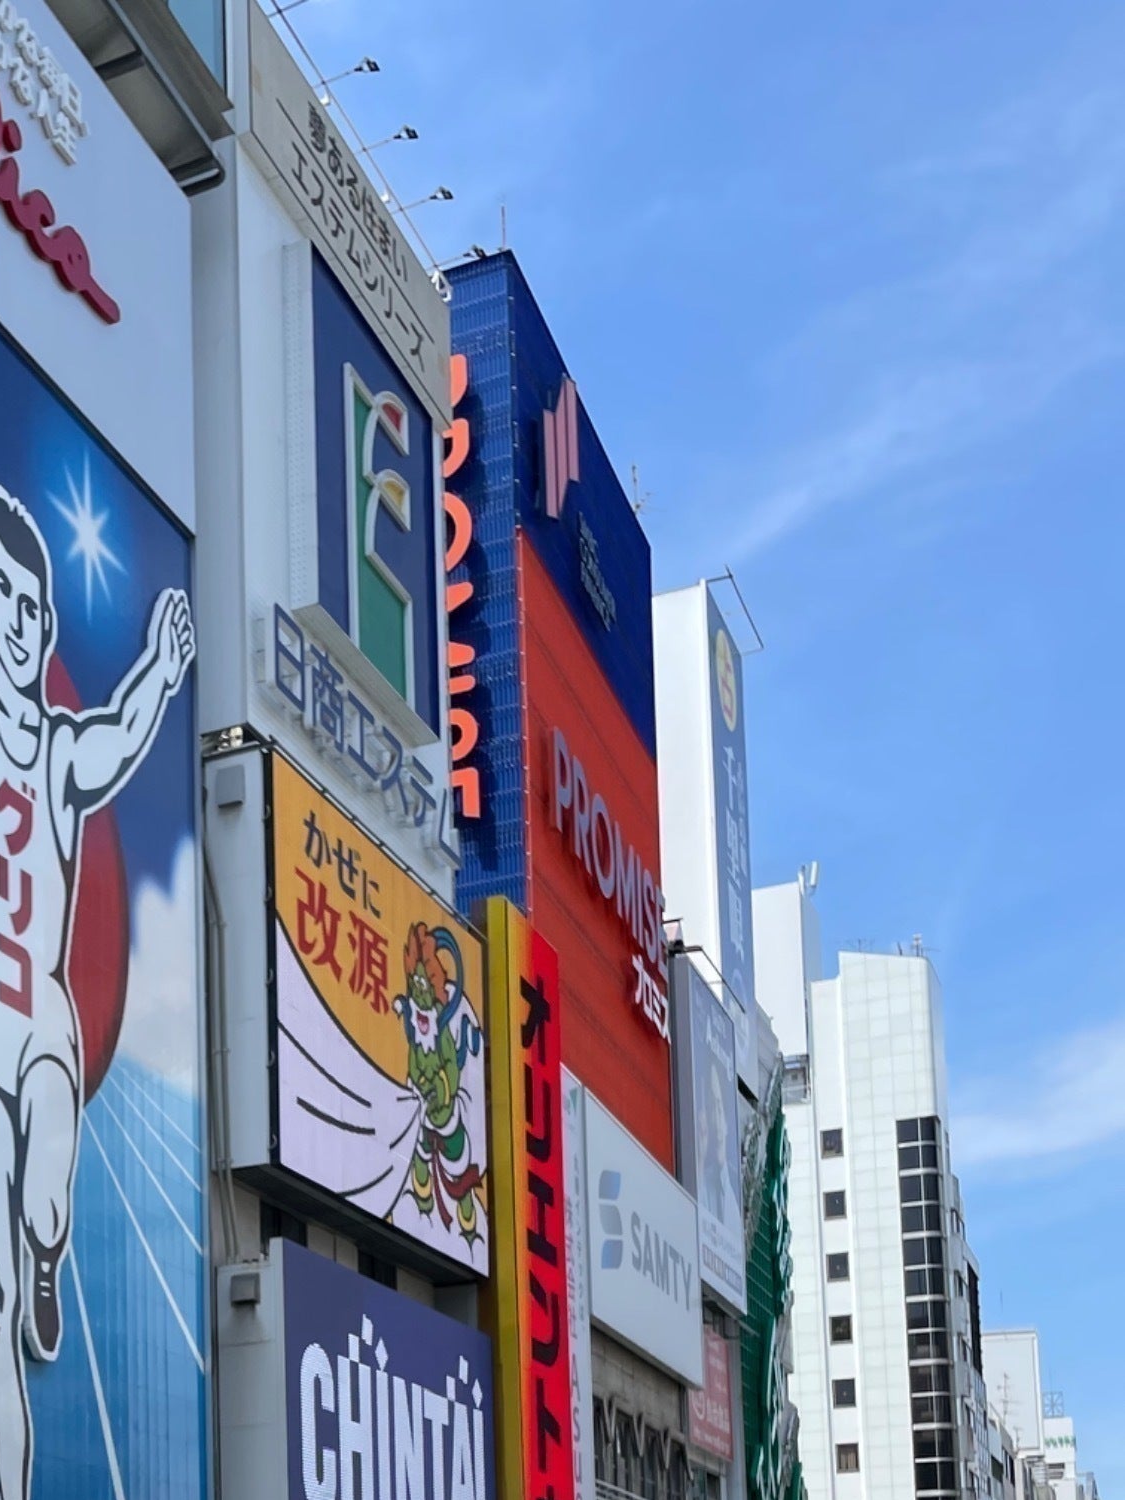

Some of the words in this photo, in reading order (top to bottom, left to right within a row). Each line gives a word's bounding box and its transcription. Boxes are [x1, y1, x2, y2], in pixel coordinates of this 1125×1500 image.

[304, 810, 381, 919] かぜに
[552, 726, 668, 984] PROMISE
[295, 866, 390, 1015] 改源
[631, 1210, 692, 1312] SAMTY
